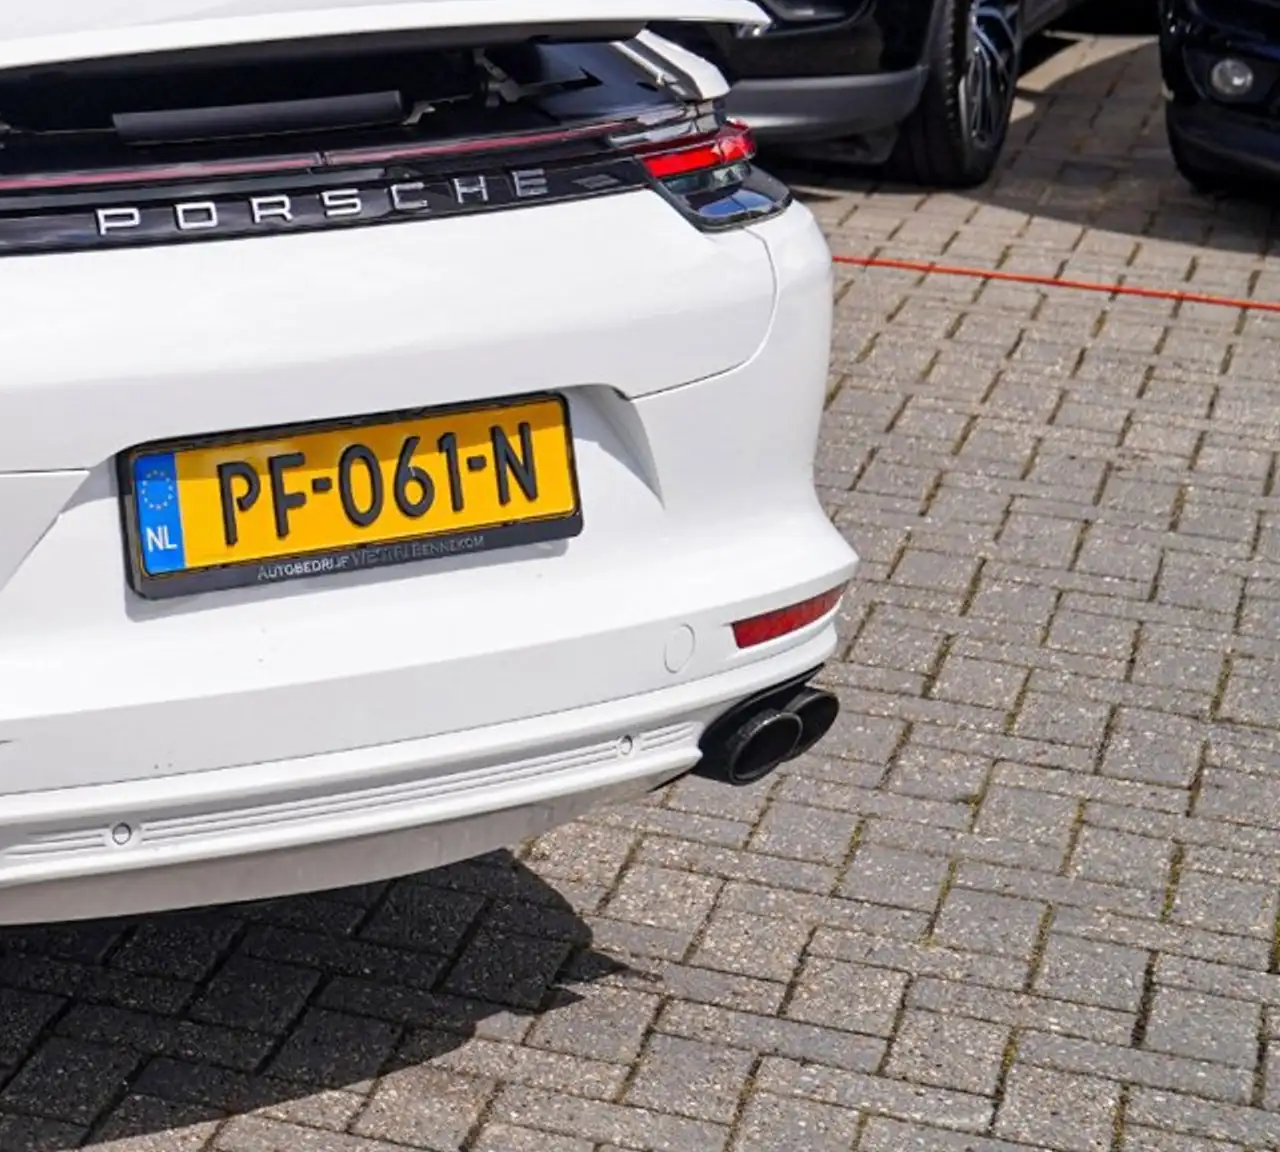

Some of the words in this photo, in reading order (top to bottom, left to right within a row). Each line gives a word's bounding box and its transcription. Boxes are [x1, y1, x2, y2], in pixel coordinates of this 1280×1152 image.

[95, 167, 548, 237] PORSCHE
[216, 421, 539, 547] PF-061-N
[145, 525, 178, 553] NL
[257, 555, 351, 582] AUTOBEDRIJF
